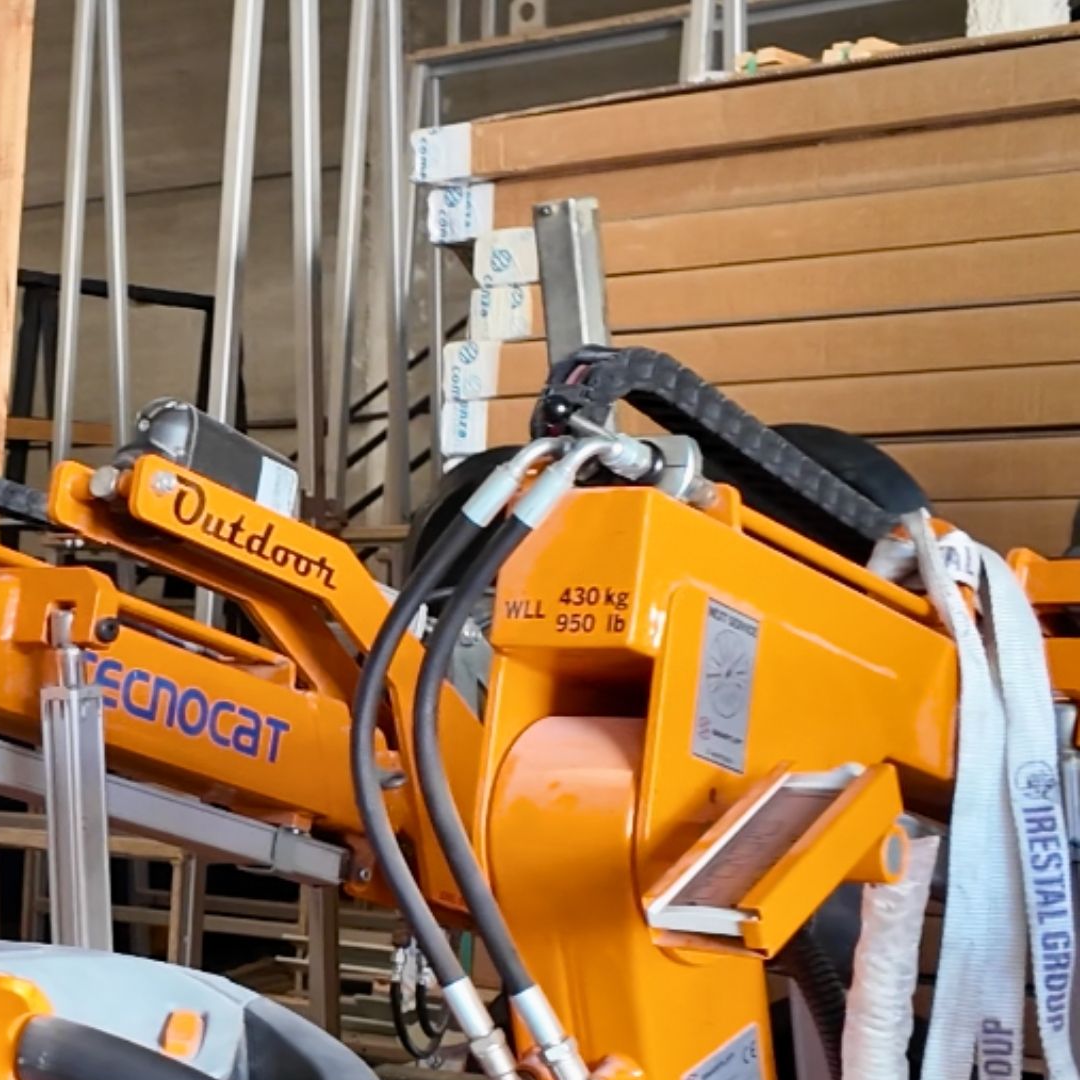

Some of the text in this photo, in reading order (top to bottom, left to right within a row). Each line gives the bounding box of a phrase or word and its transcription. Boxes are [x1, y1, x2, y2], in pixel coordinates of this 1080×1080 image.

[174, 473, 338, 591] Outdoor
[505, 600, 546, 619] WLL
[559, 586, 630, 611] 430 kg
[556, 613, 626, 633] 950 lb
[1021, 804, 1072, 1033] IRESTAL GROUP
